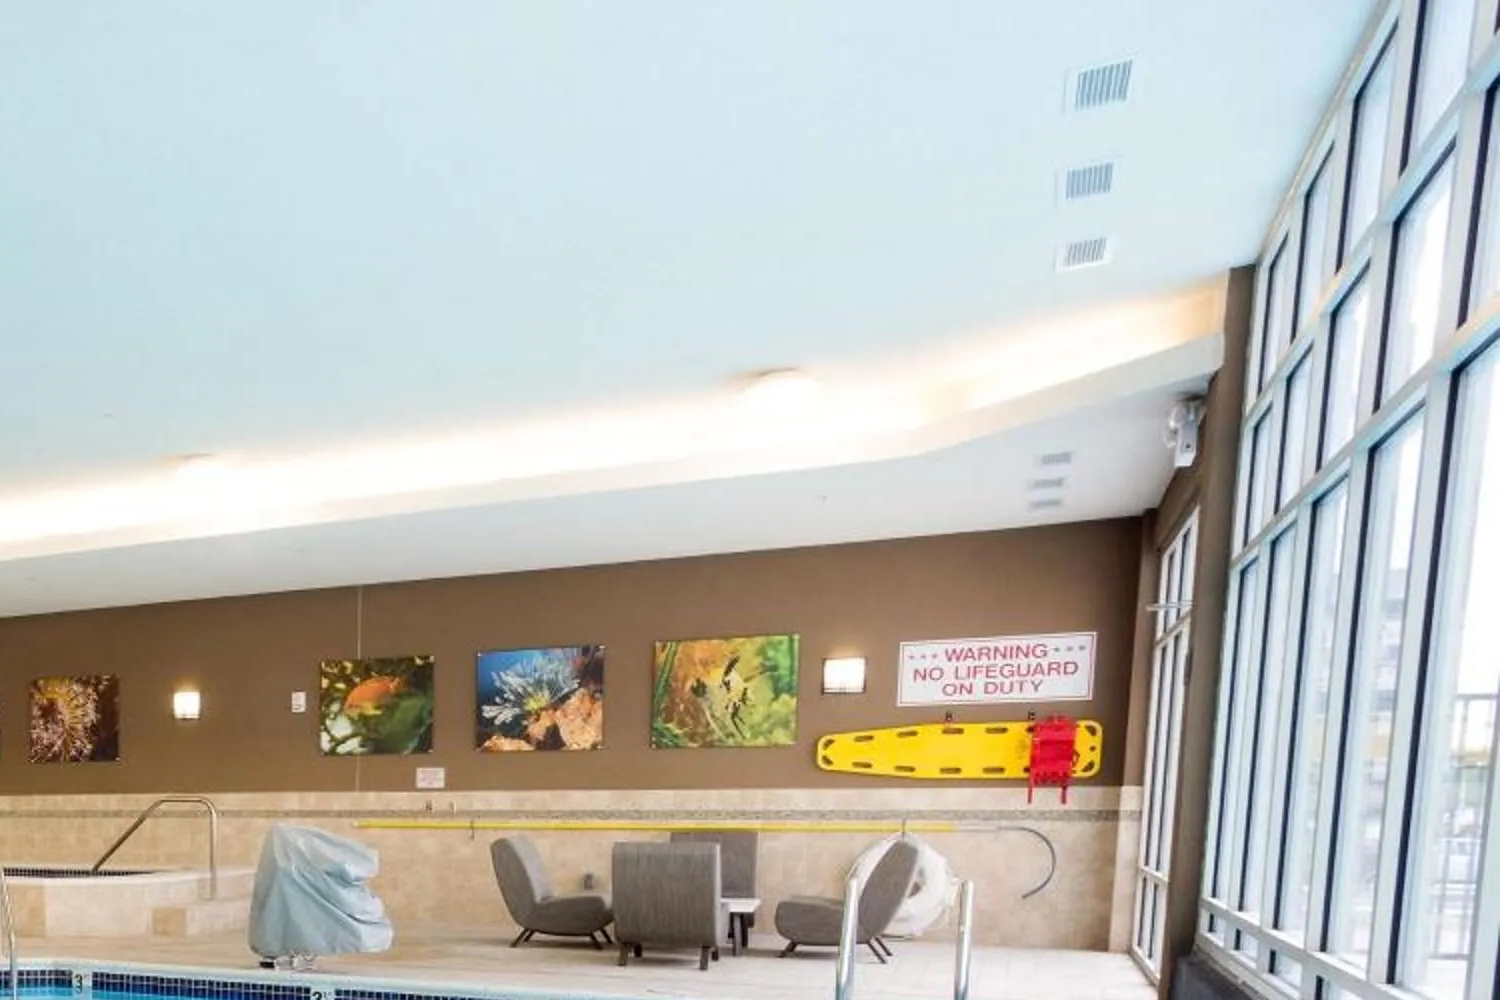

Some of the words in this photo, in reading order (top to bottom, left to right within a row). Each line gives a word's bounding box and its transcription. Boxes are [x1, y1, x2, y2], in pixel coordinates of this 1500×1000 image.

[944, 643, 1049, 662] WARNING
[913, 667, 945, 682] NO
[955, 661, 1079, 680] LIFEGUARD
[942, 682, 974, 697] ON
[984, 680, 1044, 695] DUTY
